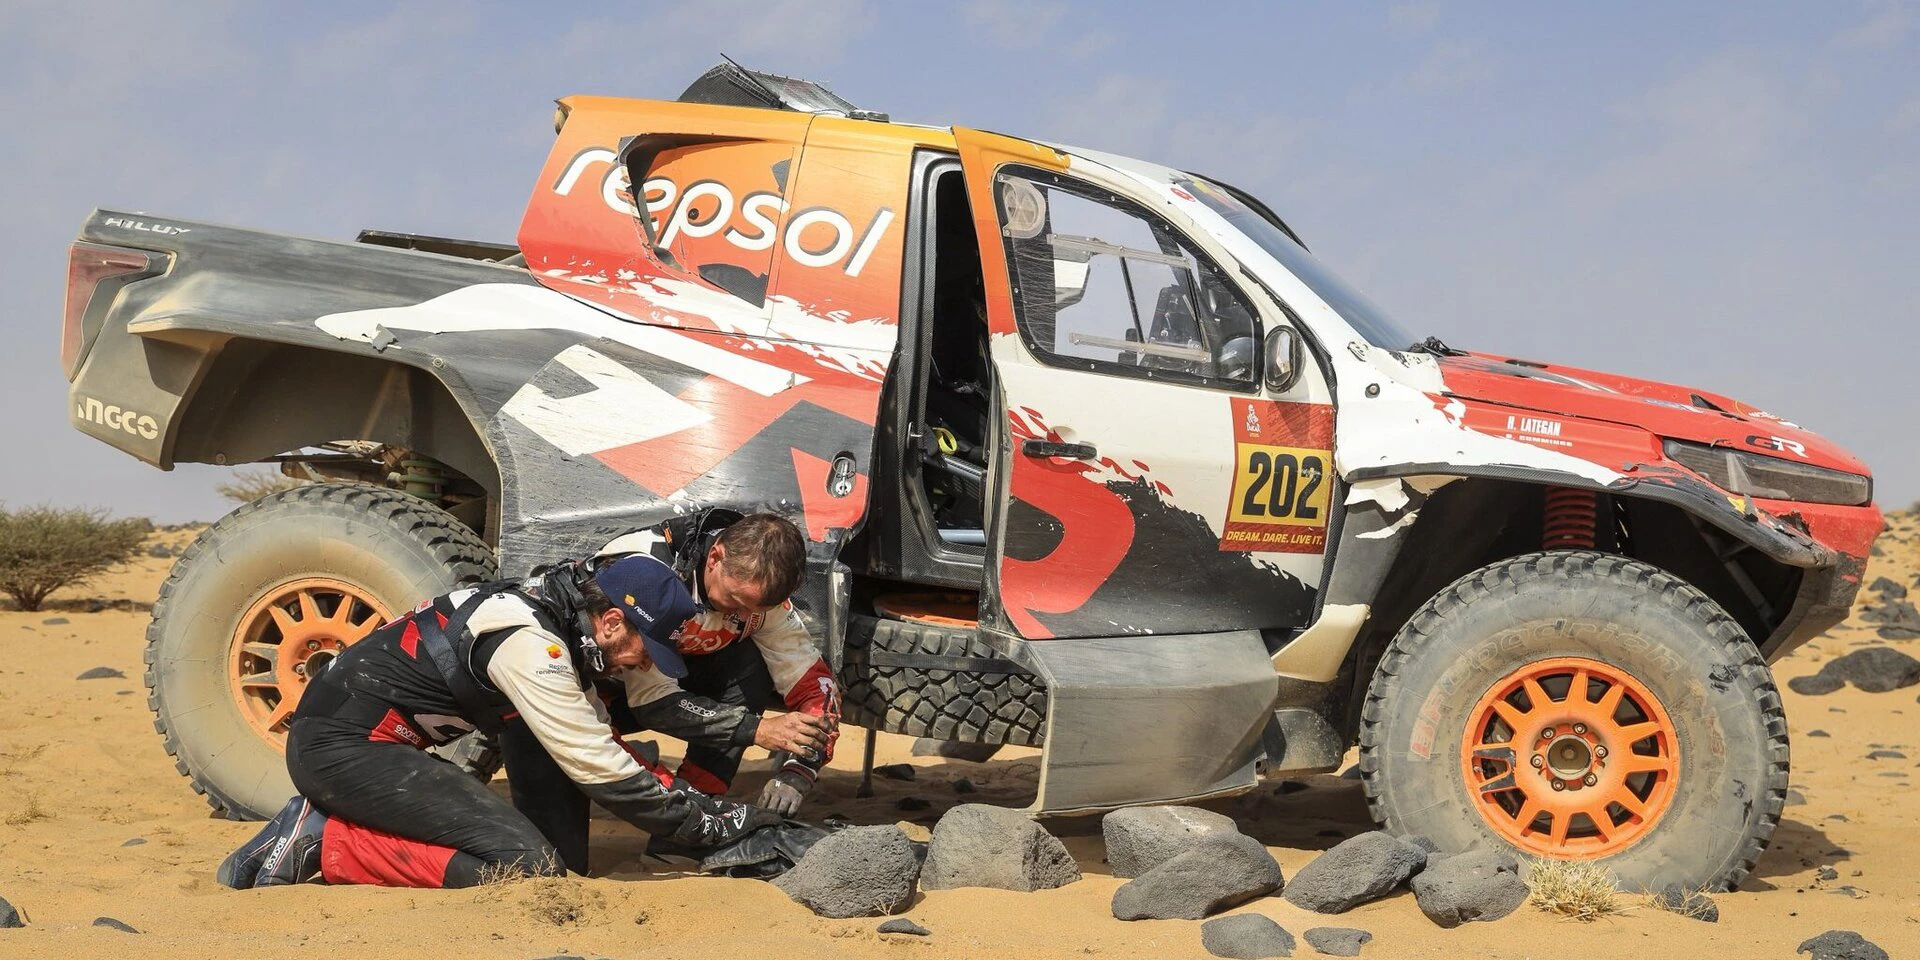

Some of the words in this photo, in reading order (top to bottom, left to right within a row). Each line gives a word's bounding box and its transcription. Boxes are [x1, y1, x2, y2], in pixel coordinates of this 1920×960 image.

[552, 147, 896, 278] repsol
[104, 217, 191, 235] HILUX
[1520, 417, 1562, 436] LATEGAN
[1745, 435, 1808, 458] GR
[1241, 451, 1323, 520] 202
[1226, 530, 1261, 541] DREAM.
[1263, 532, 1289, 543] DARE.
[1290, 534, 1311, 545] LIVE
[633, 604, 655, 623] repsol
